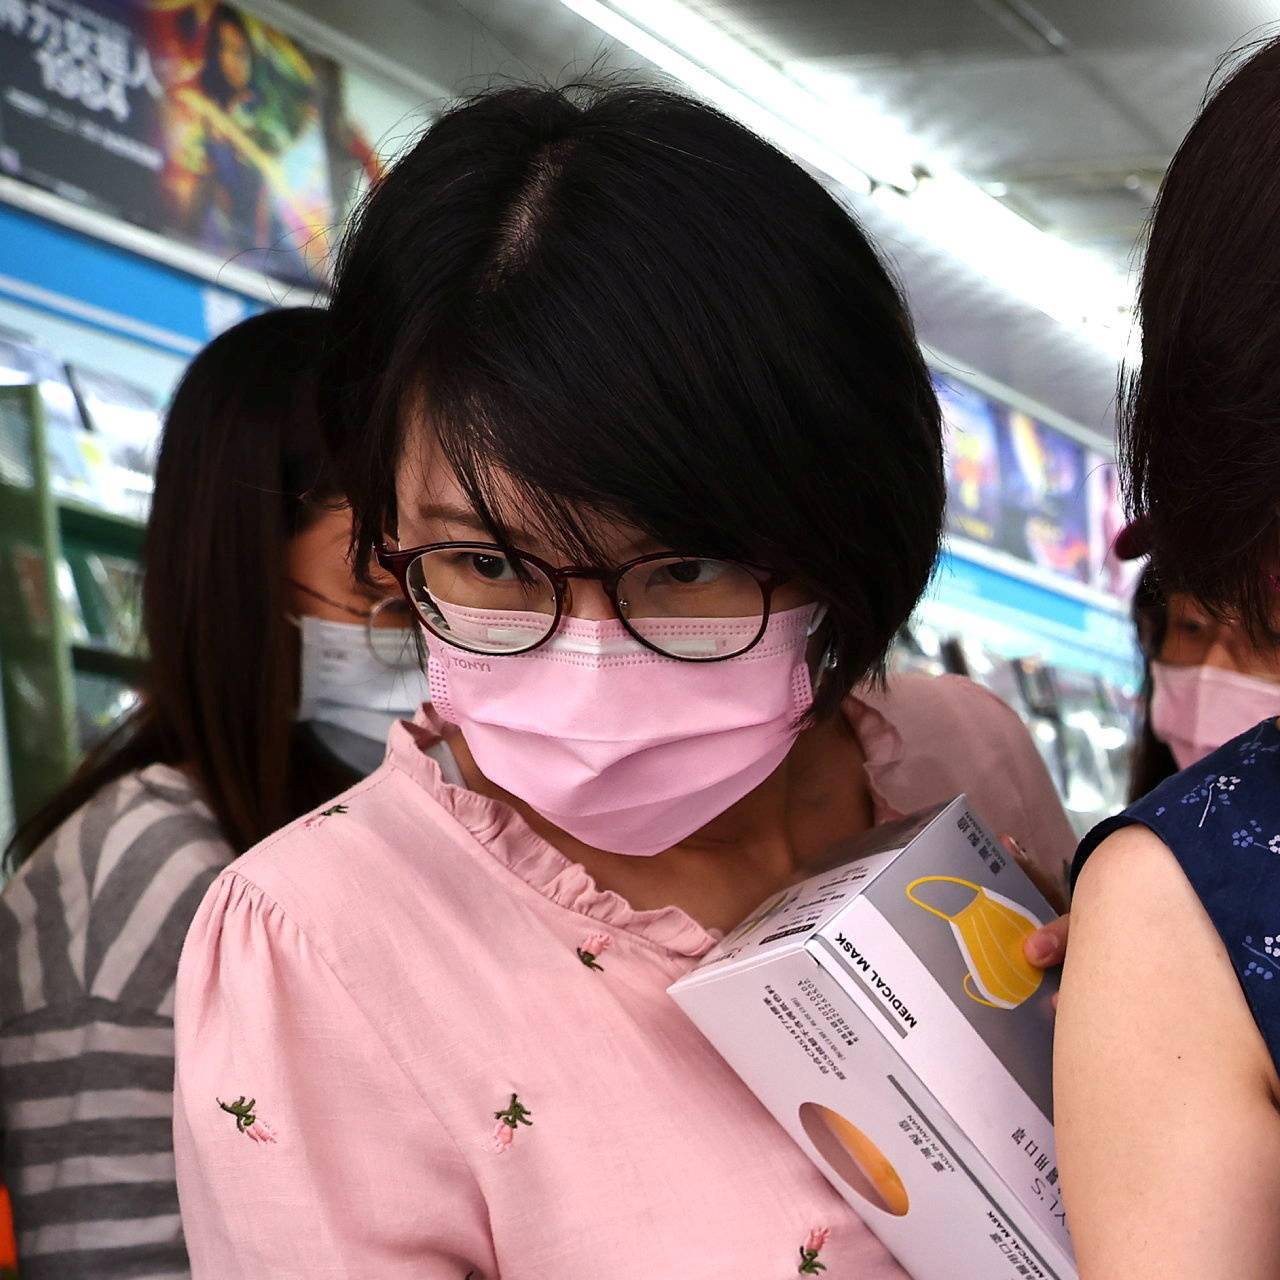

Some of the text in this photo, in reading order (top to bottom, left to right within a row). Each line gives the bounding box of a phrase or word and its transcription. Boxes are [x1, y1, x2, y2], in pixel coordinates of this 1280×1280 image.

[834, 932, 917, 1030] MEDICAL MASK
[986, 1210, 1012, 1238] MASK
[1011, 1238, 1045, 1280] MEDICAL
